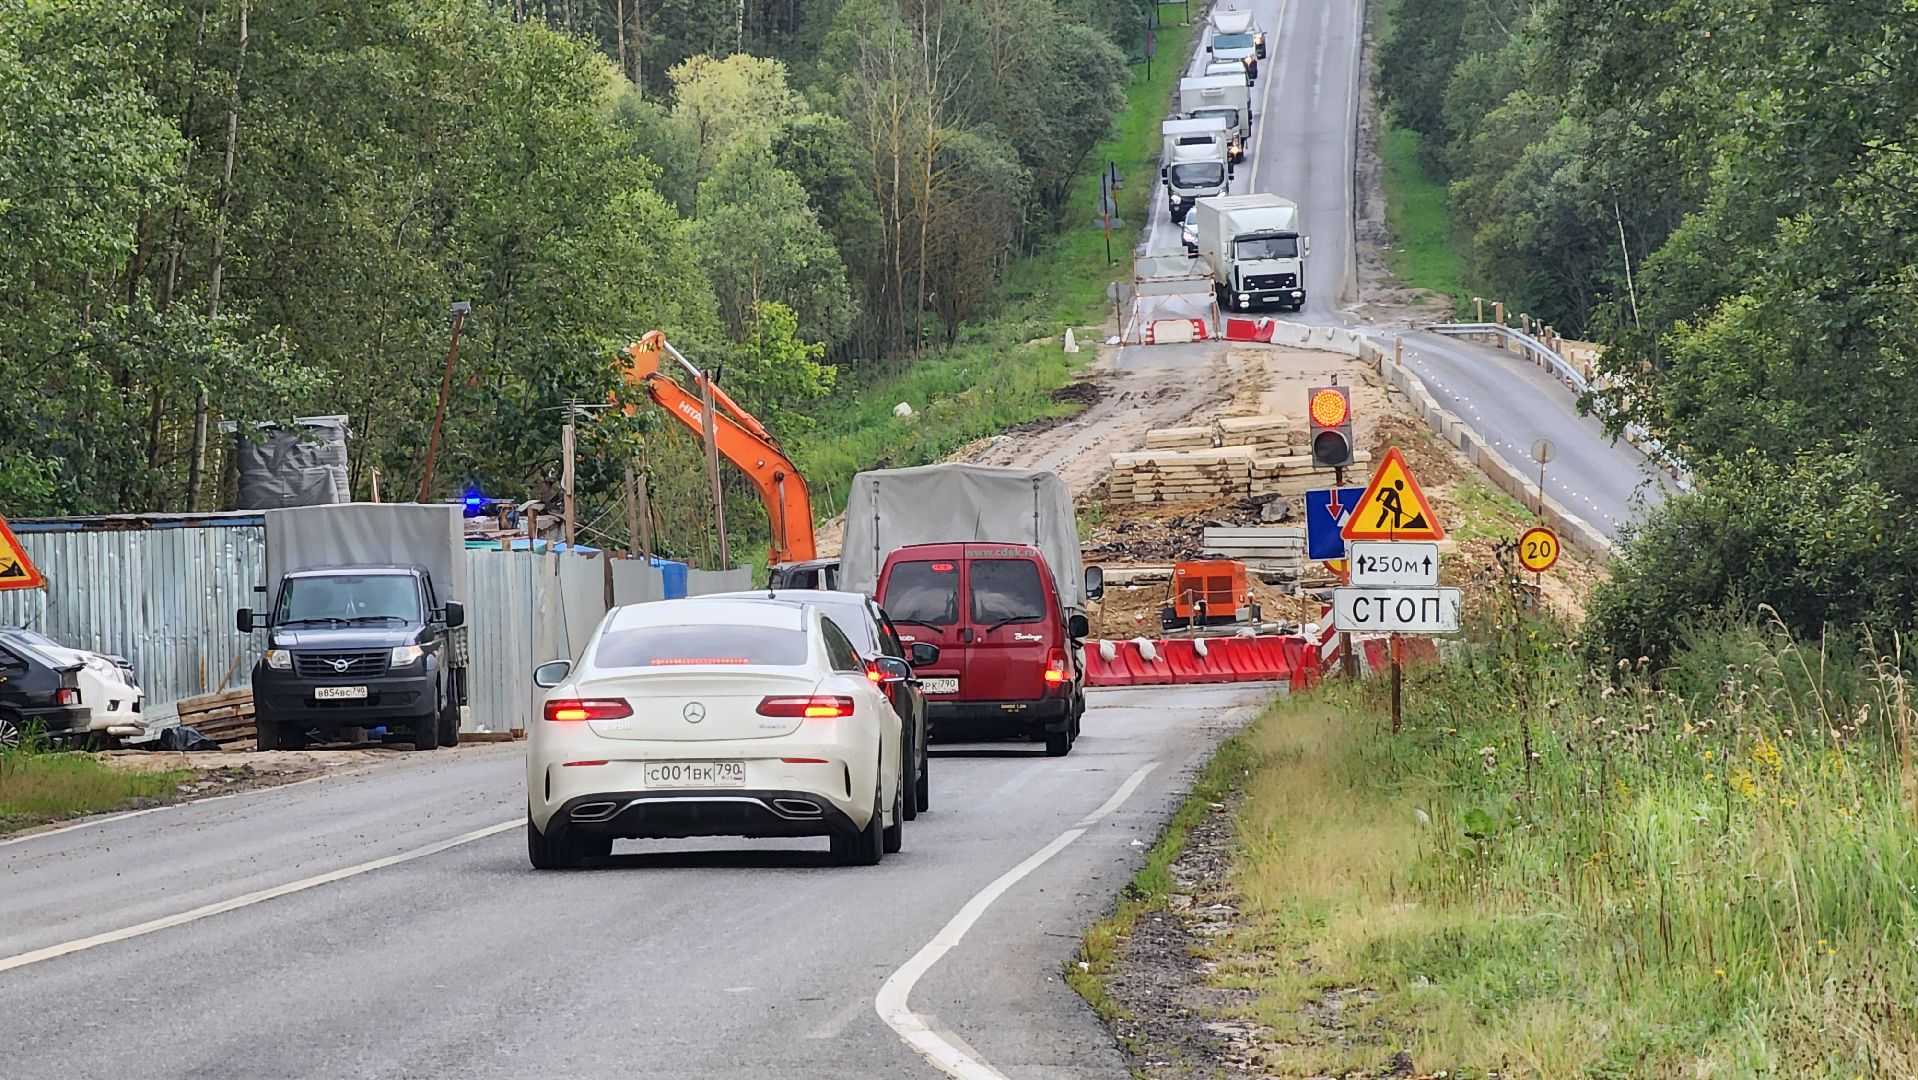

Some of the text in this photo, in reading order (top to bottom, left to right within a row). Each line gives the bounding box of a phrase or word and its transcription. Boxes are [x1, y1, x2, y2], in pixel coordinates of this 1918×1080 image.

[966, 547, 1037, 557] www.cdek.ru
[1527, 541, 1551, 559] 20
[1352, 596, 1440, 623] СТОП
[940, 679, 956, 688] 790
[650, 763, 741, 781] С001ВК 790
